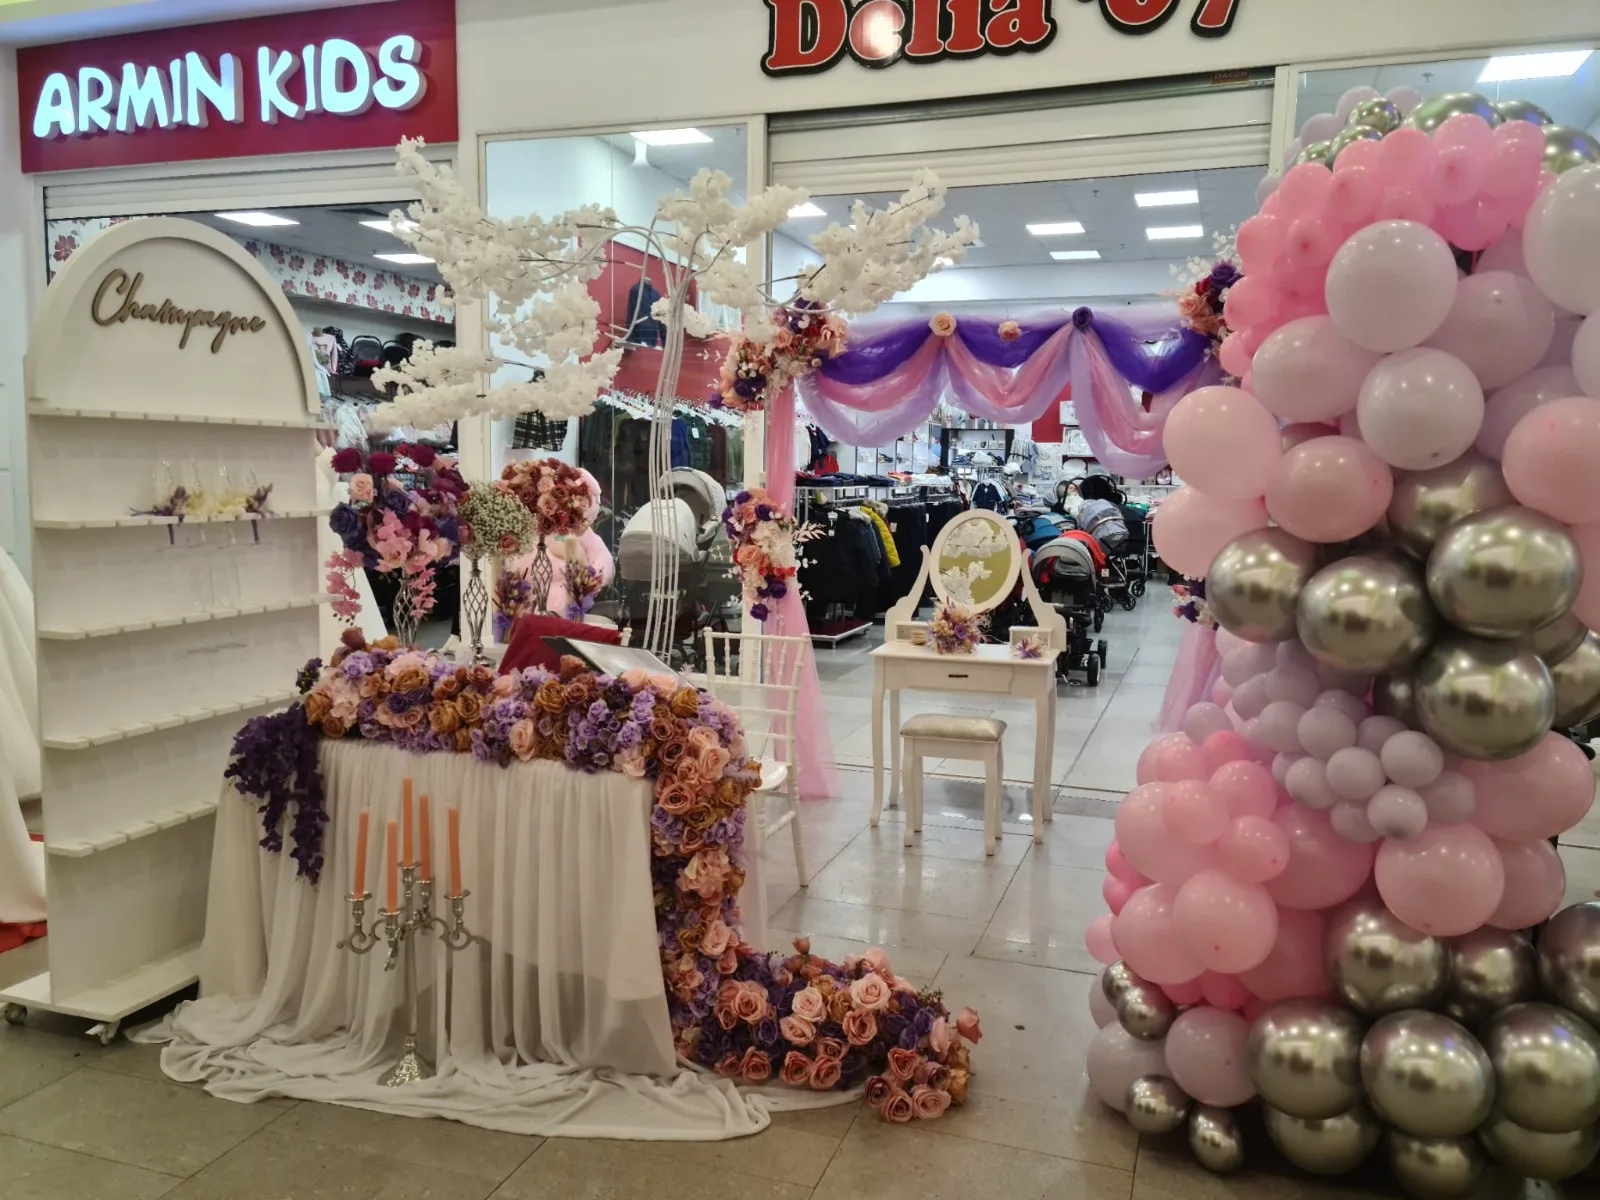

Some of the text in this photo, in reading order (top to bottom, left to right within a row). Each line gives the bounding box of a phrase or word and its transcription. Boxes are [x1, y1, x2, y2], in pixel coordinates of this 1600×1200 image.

[761, 0, 1239, 76] Delia
[33, 35, 425, 138] ARMIN KIDS
[92, 268, 266, 354] Champagne
